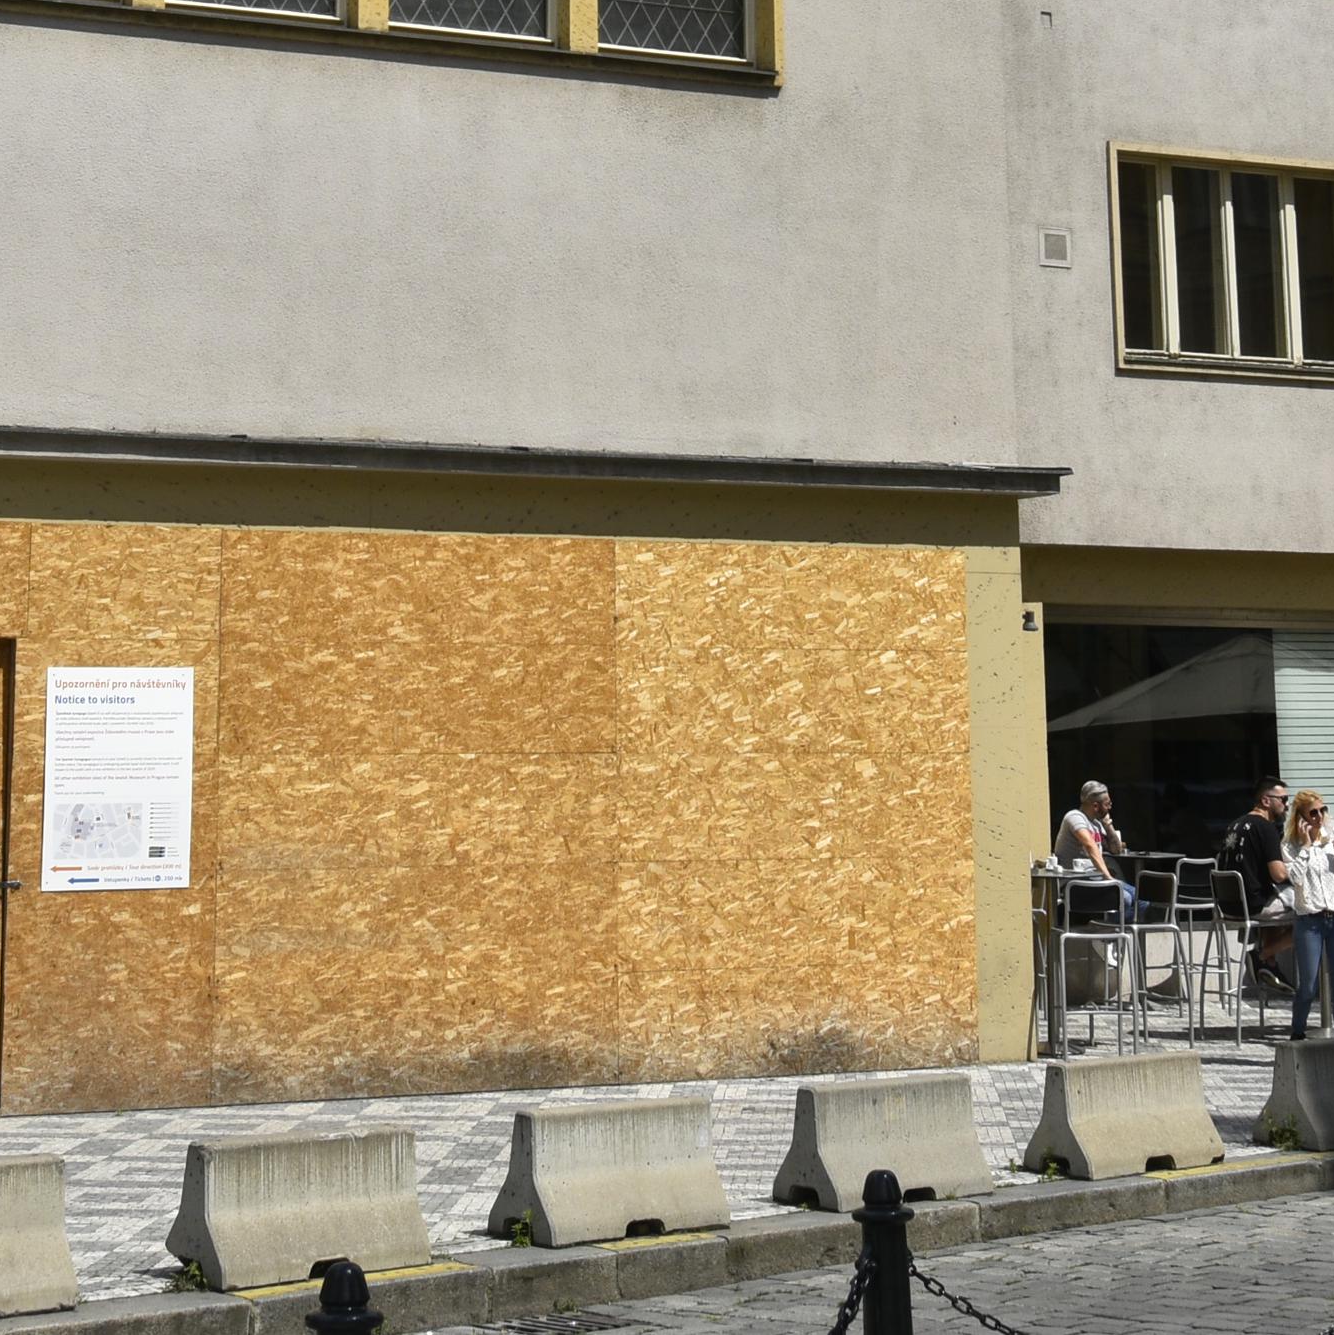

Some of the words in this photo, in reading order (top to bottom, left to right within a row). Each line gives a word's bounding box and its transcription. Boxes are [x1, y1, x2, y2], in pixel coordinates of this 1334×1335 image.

[55, 679, 110, 690] Upozornění
[111, 682, 128, 690] pro
[130, 678, 187, 690] návštěvníky
[54, 695, 86, 704] Notice
[88, 696, 98, 704] to
[100, 694, 136, 704] visitors
